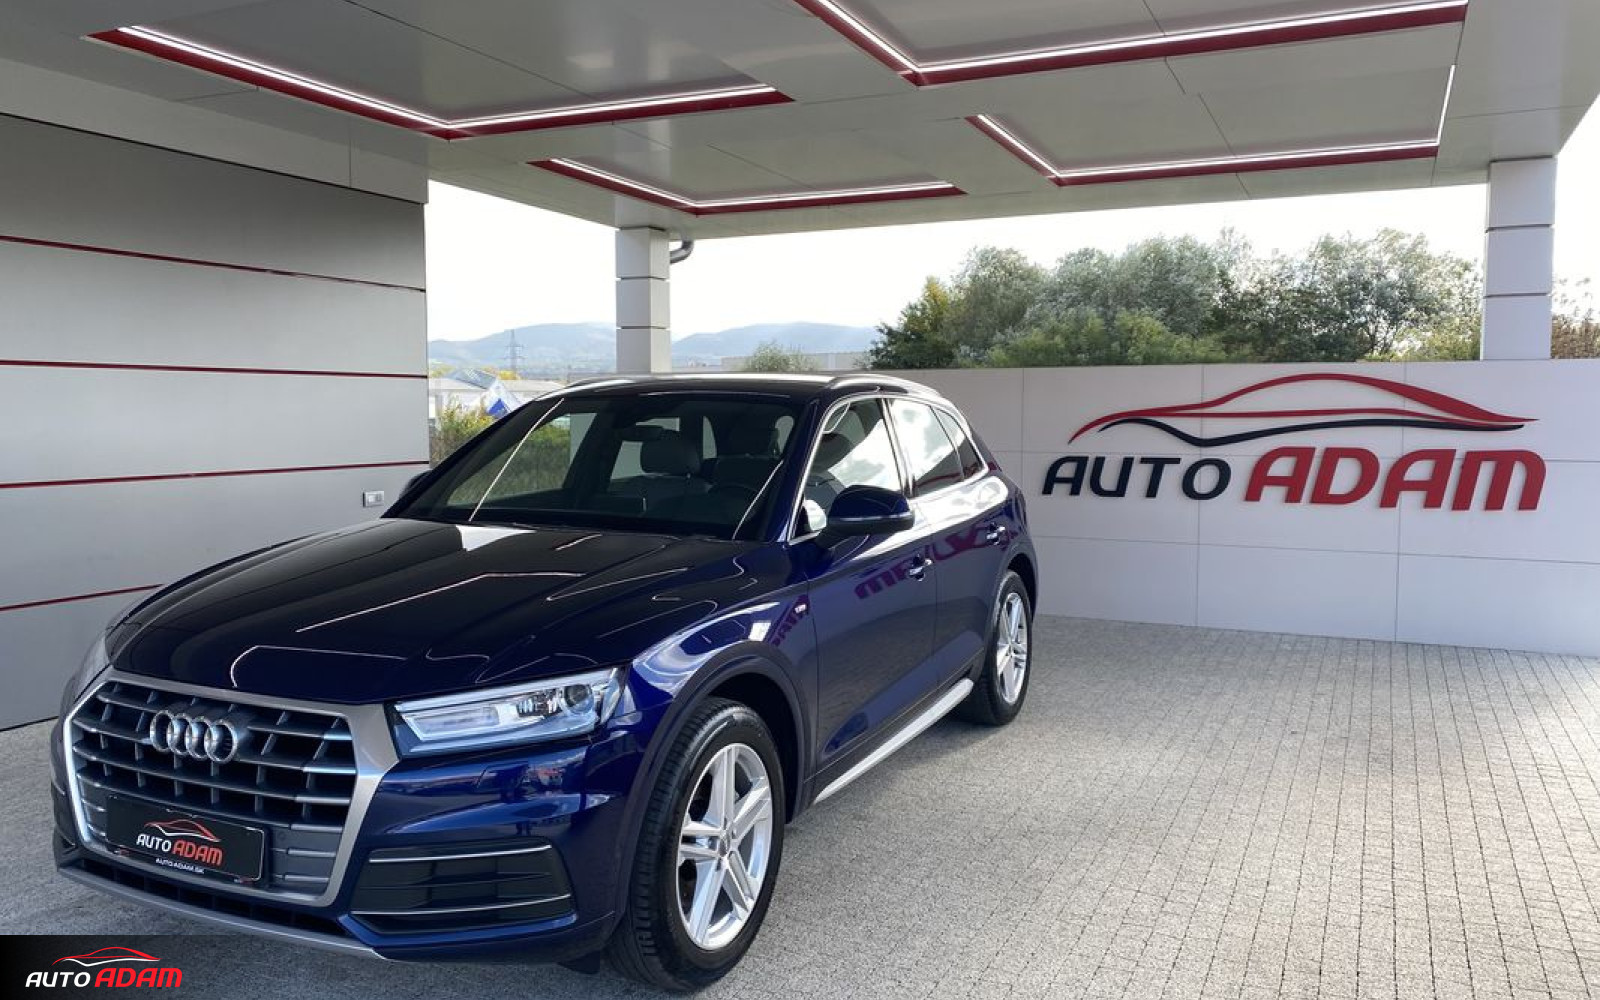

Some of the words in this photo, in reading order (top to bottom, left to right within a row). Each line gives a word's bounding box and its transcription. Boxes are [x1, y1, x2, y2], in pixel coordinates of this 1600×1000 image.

[1042, 456, 1232, 501] AUTO
[1245, 446, 1547, 511] ADAM
[136, 833, 172, 852] AUTO
[172, 839, 224, 867] ADAM
